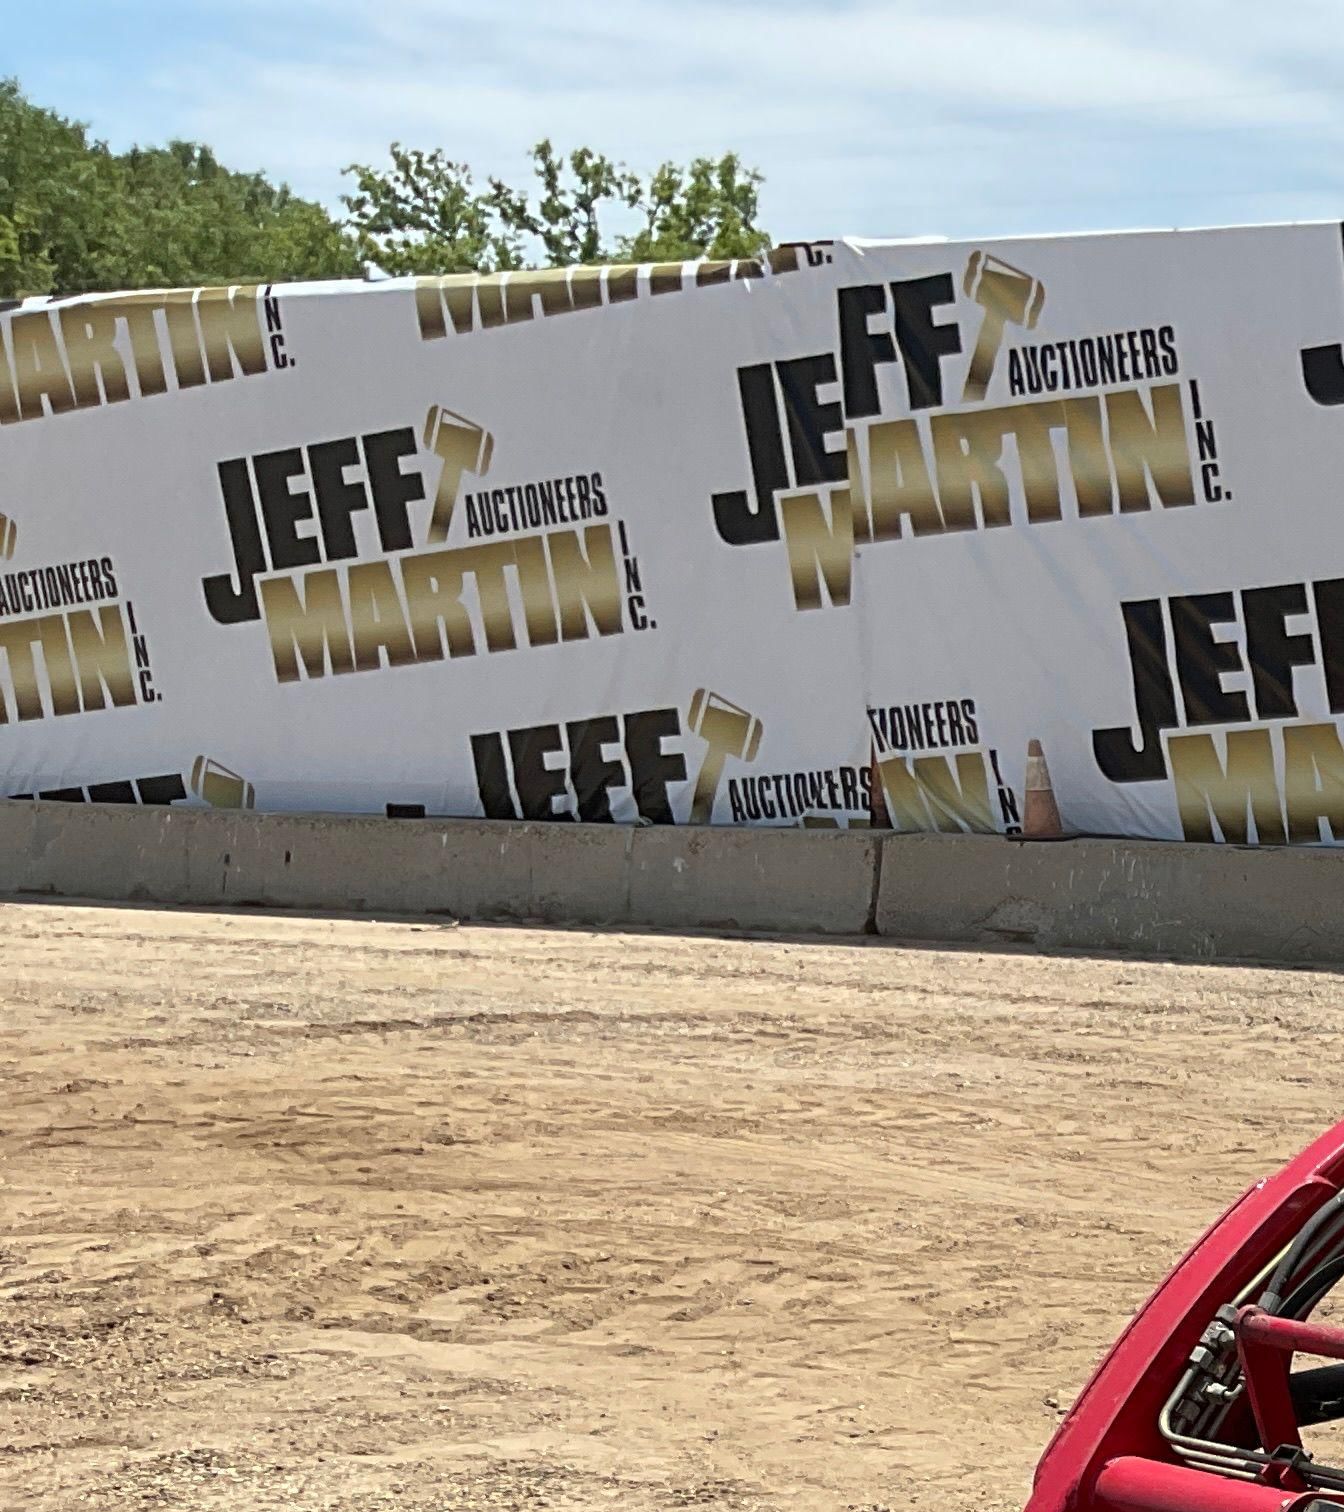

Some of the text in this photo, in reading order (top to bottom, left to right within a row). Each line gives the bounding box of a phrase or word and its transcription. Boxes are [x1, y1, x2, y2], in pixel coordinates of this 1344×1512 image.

[0, 287, 267, 425] ARTIN
[712, 272, 962, 546] JEFF
[1008, 325, 1180, 397] AUCTIONEERS
[781, 384, 1197, 612] MARTIN
[1189, 379, 1232, 503] INC.
[202, 426, 426, 625] JEFF
[465, 472, 608, 538] AUCTIONEERS
[260, 523, 624, 683] MARTIN
[617, 520, 657, 632] INC.
[0, 604, 138, 725] TIN
[127, 601, 163, 703] INC.
